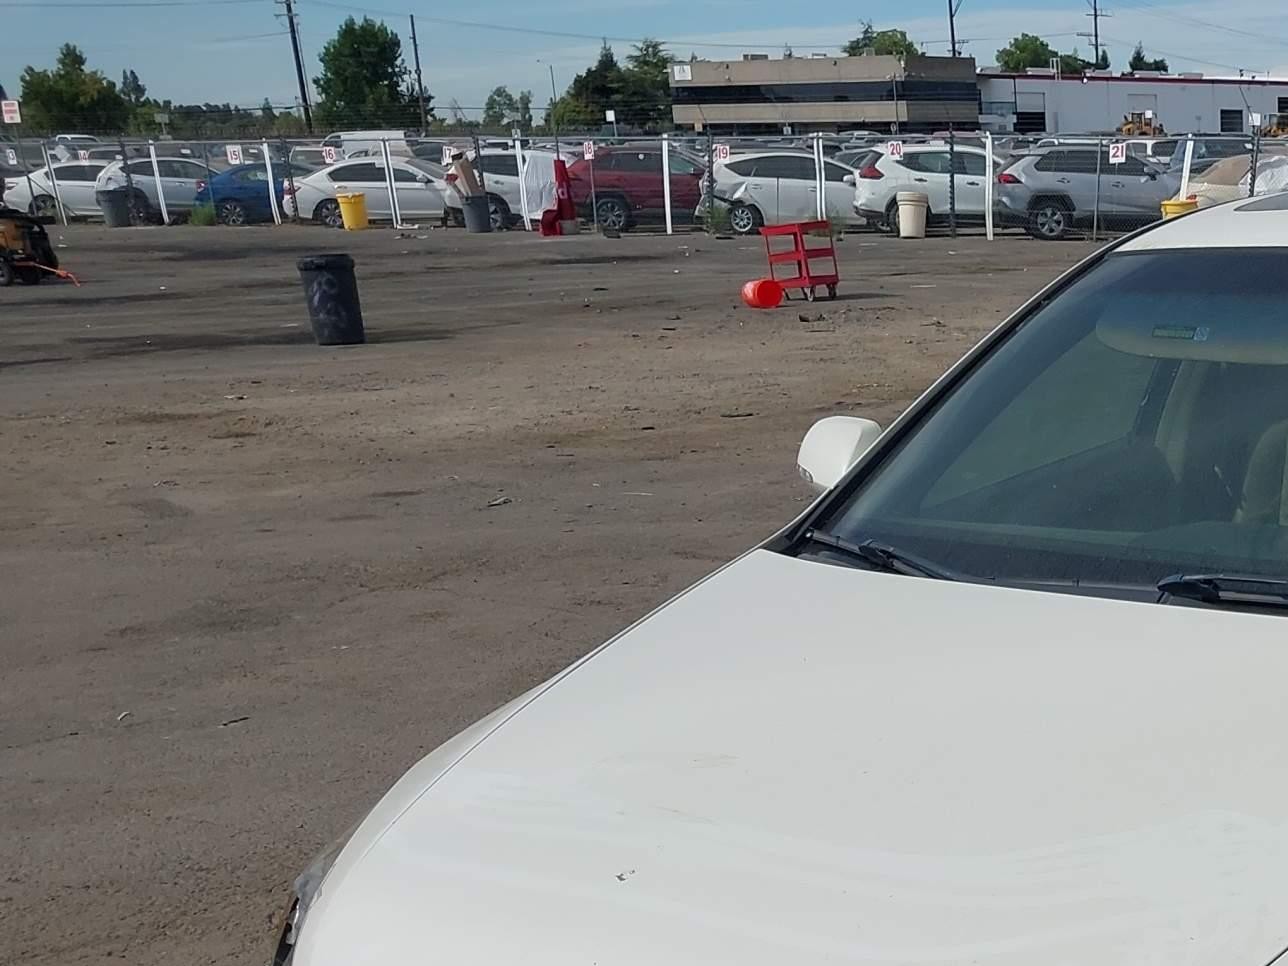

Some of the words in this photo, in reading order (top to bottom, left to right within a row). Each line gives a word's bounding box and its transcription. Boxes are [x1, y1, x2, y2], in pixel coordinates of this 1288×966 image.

[229, 149, 239, 161] 15
[324, 148, 334, 160] 16
[584, 143, 593, 155] 18
[717, 146, 728, 159] 19
[889, 142, 902, 156] 20
[1110, 145, 1124, 158] 21
